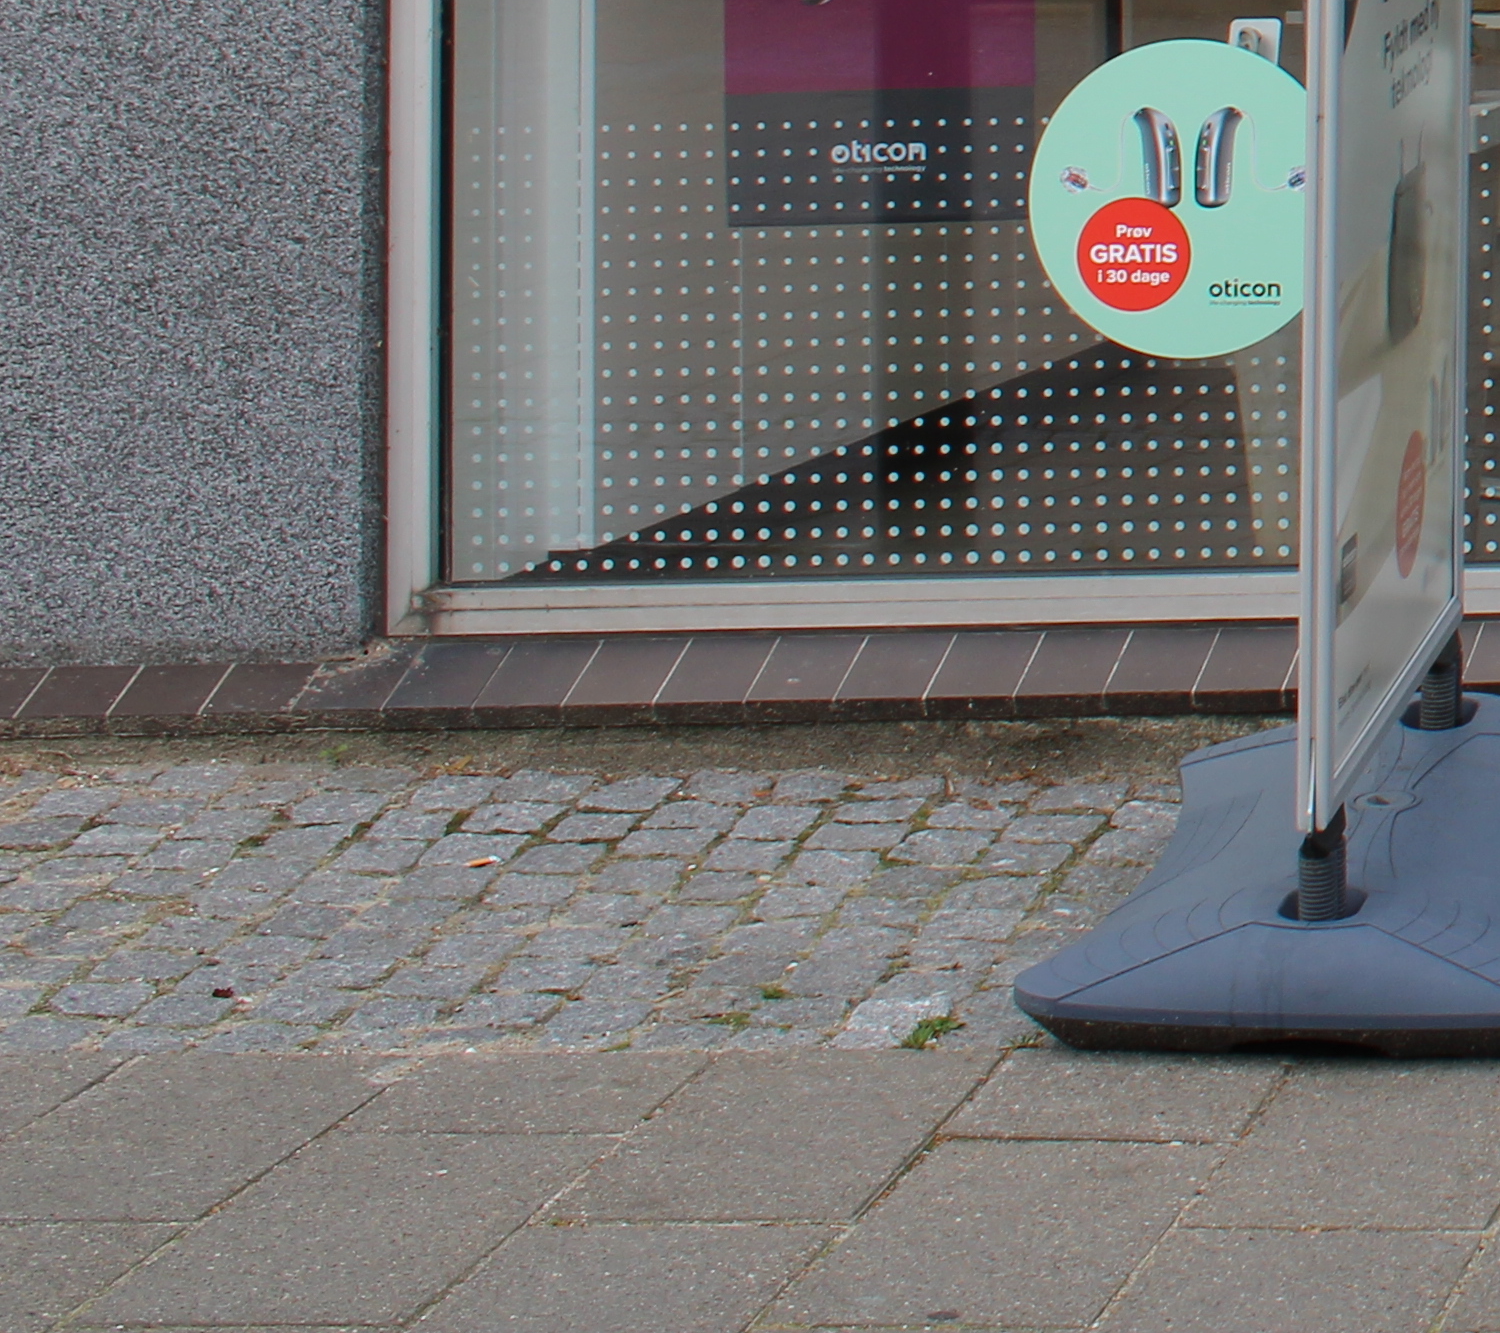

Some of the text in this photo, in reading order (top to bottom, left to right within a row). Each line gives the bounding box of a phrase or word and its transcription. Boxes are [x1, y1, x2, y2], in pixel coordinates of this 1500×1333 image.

[830, 138, 928, 164] oticon
[1115, 223, 1152, 238] Prøv
[1089, 243, 1178, 264] GRATIS
[1097, 269, 1170, 286] i 30 dage
[1209, 278, 1281, 297] oticon
